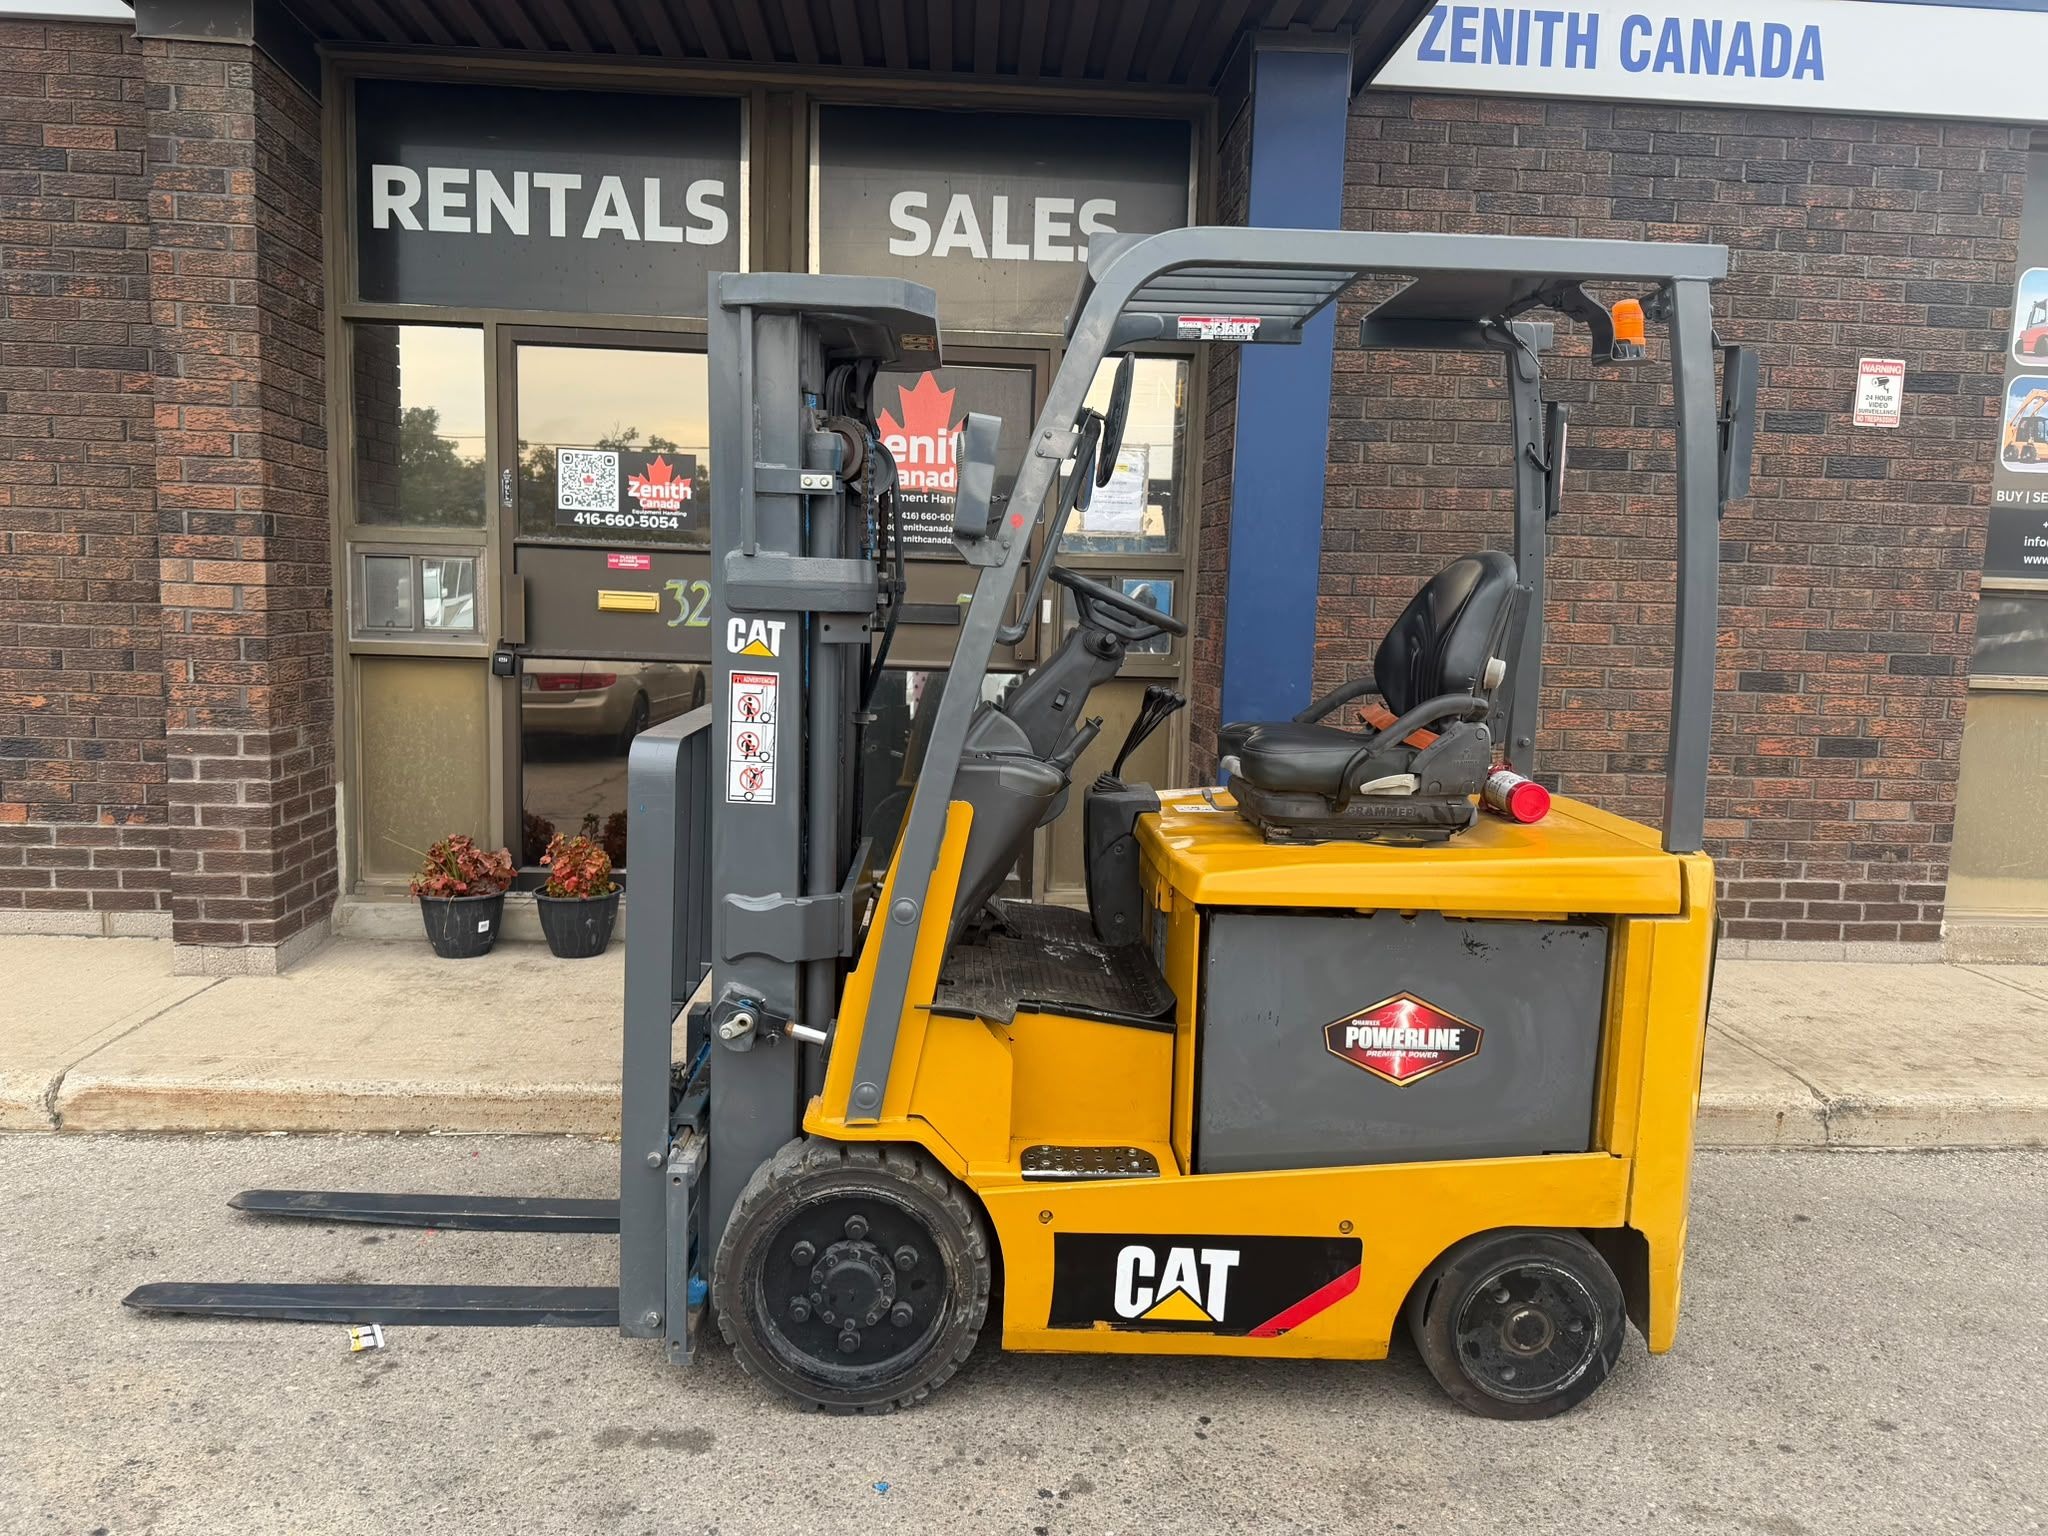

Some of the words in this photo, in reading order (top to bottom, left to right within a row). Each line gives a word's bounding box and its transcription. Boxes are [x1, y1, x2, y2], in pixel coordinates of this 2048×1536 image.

[1417, 5, 1600, 70] ZENITH
[1620, 14, 1825, 81] CANADA
[371, 164, 730, 246] RENTALS
[1861, 363, 1902, 375] WARNING
[881, 428, 958, 464] enit
[898, 467, 957, 488] anad
[628, 480, 692, 500] Zenith
[1996, 490, 2023, 502] BUY
[632, 508, 661, 516] Equipment
[662, 510, 688, 518] Handling
[639, 498, 681, 509] Canada
[574, 512, 679, 529] 416-660-5054
[663, 579, 712, 627] 32
[726, 617, 786, 657] CAT
[1346, 806, 1417, 817] GRAMMER
[1345, 1026, 1460, 1051] POWERLINE
[1366, 1050, 1407, 1058] PREMIUM
[1114, 1245, 1240, 1322] CAT
